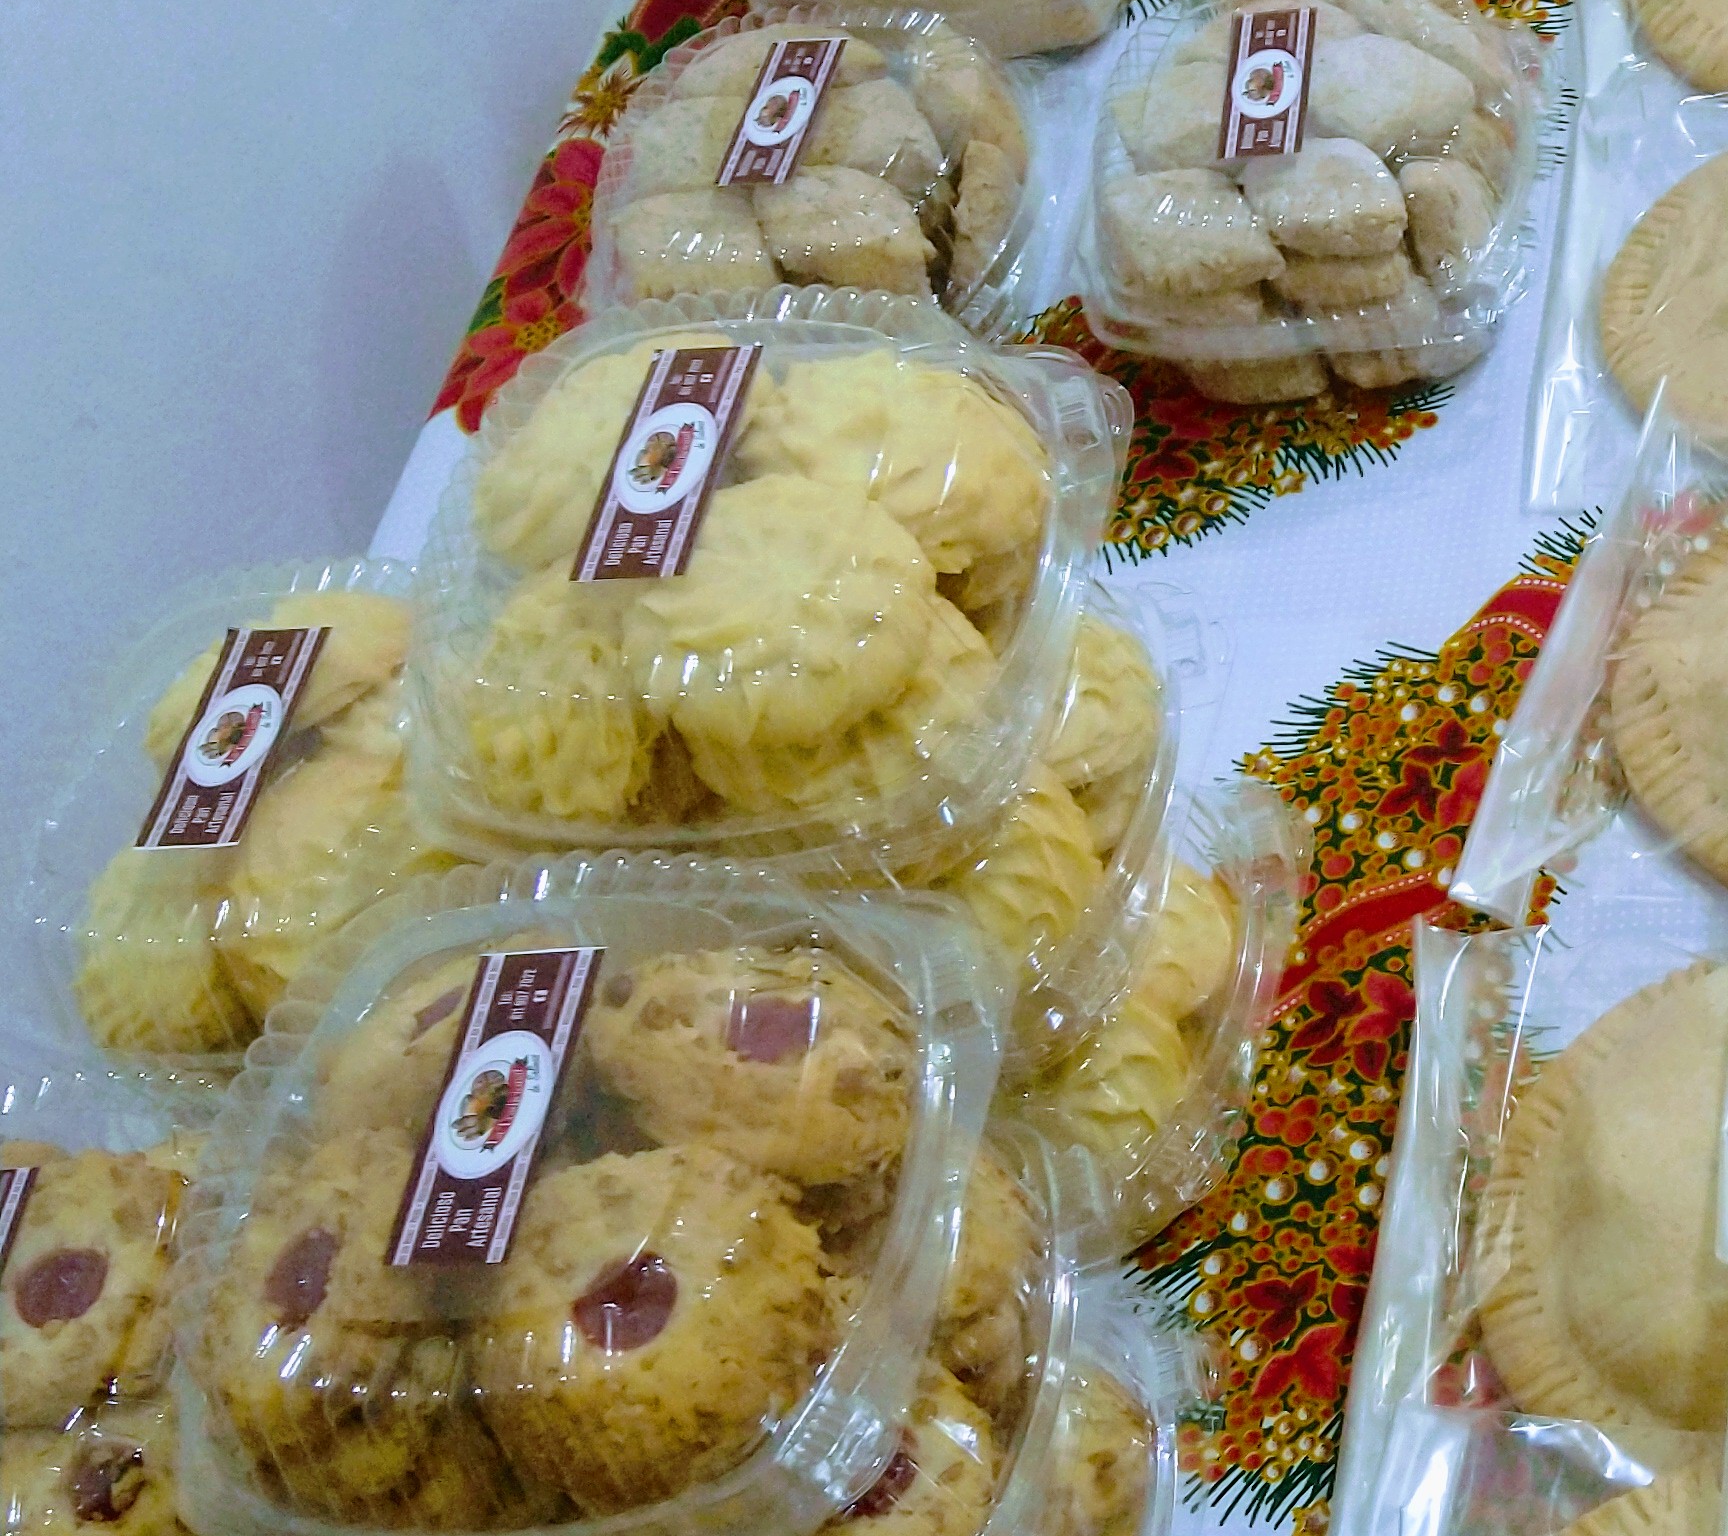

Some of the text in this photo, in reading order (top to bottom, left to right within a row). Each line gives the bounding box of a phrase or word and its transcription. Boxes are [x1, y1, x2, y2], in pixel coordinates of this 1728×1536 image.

[629, 535, 649, 554] Pan
[641, 519, 673, 565] Artesanal
[420, 1191, 457, 1248] Delicioso
[448, 1208, 475, 1232] Pan
[465, 1186, 502, 1247] Artesanal
